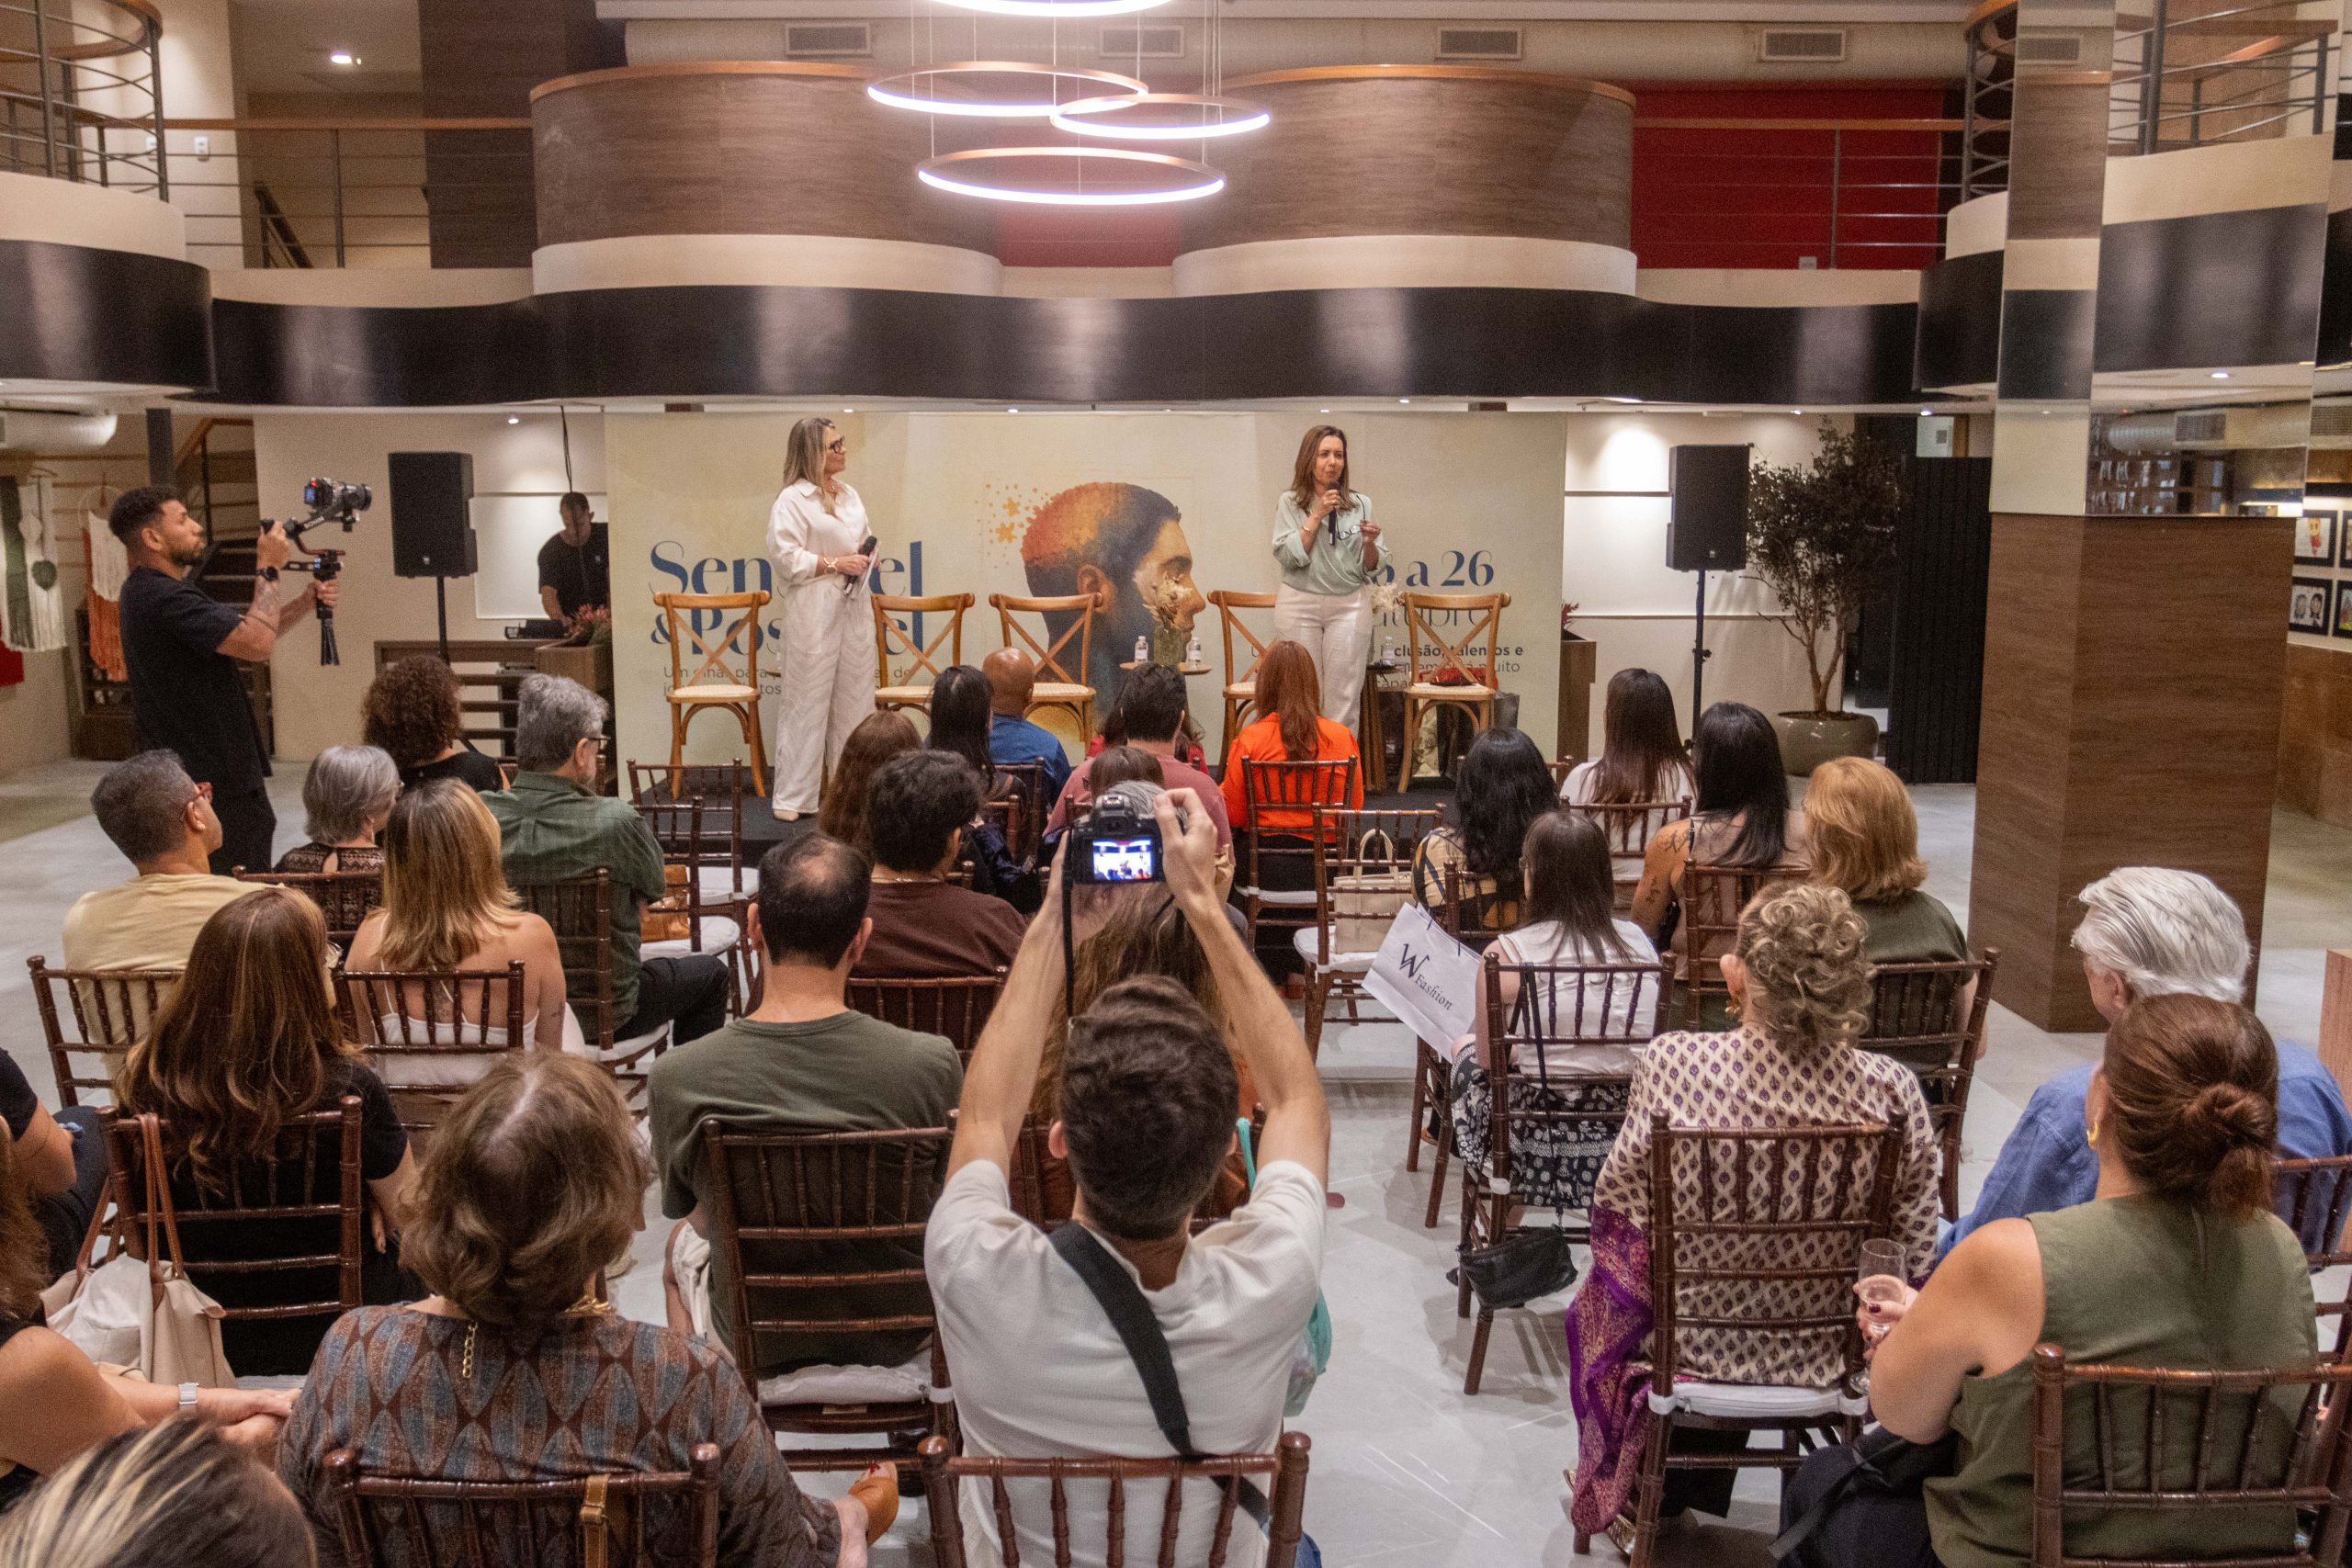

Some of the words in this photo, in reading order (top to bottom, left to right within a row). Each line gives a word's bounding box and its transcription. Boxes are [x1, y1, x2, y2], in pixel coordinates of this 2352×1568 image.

[1406, 560, 1430, 587] a
[1440, 549, 1495, 587] 26
[1514, 647, 1524, 657] e
[1398, 942, 1430, 979] W
[1415, 974, 1453, 1010] Fashion
